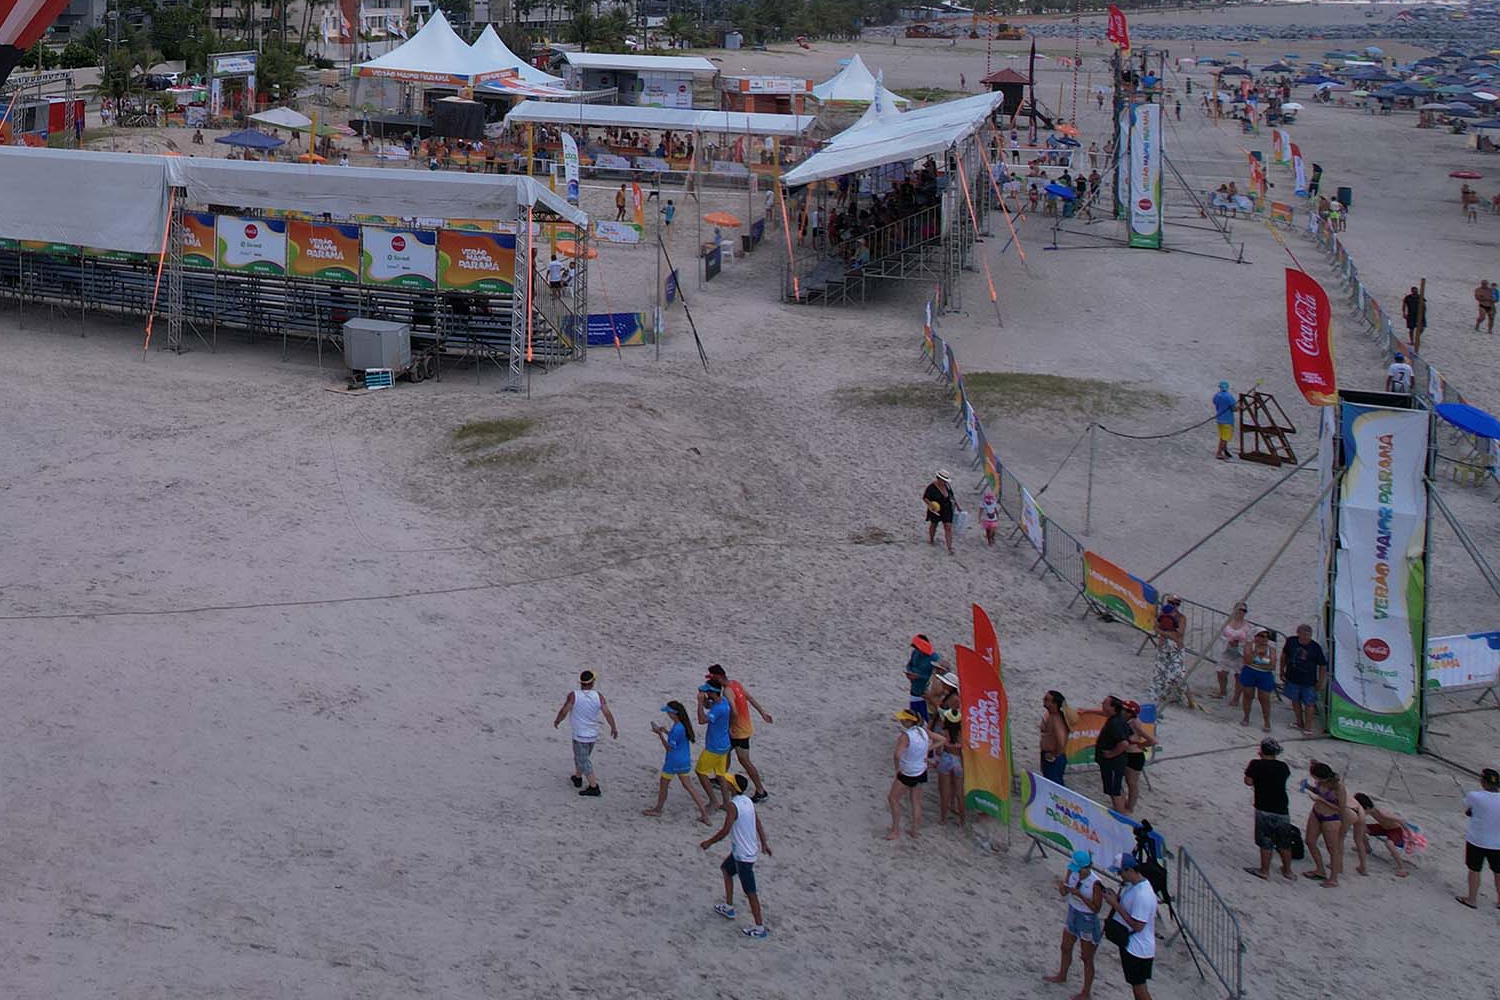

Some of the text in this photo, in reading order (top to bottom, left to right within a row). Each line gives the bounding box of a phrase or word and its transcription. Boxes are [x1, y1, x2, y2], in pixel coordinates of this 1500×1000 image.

[1294, 289, 1320, 357] Coca-Cola
[1369, 434, 1394, 620] VERÃO MAIOR PARANÁ
